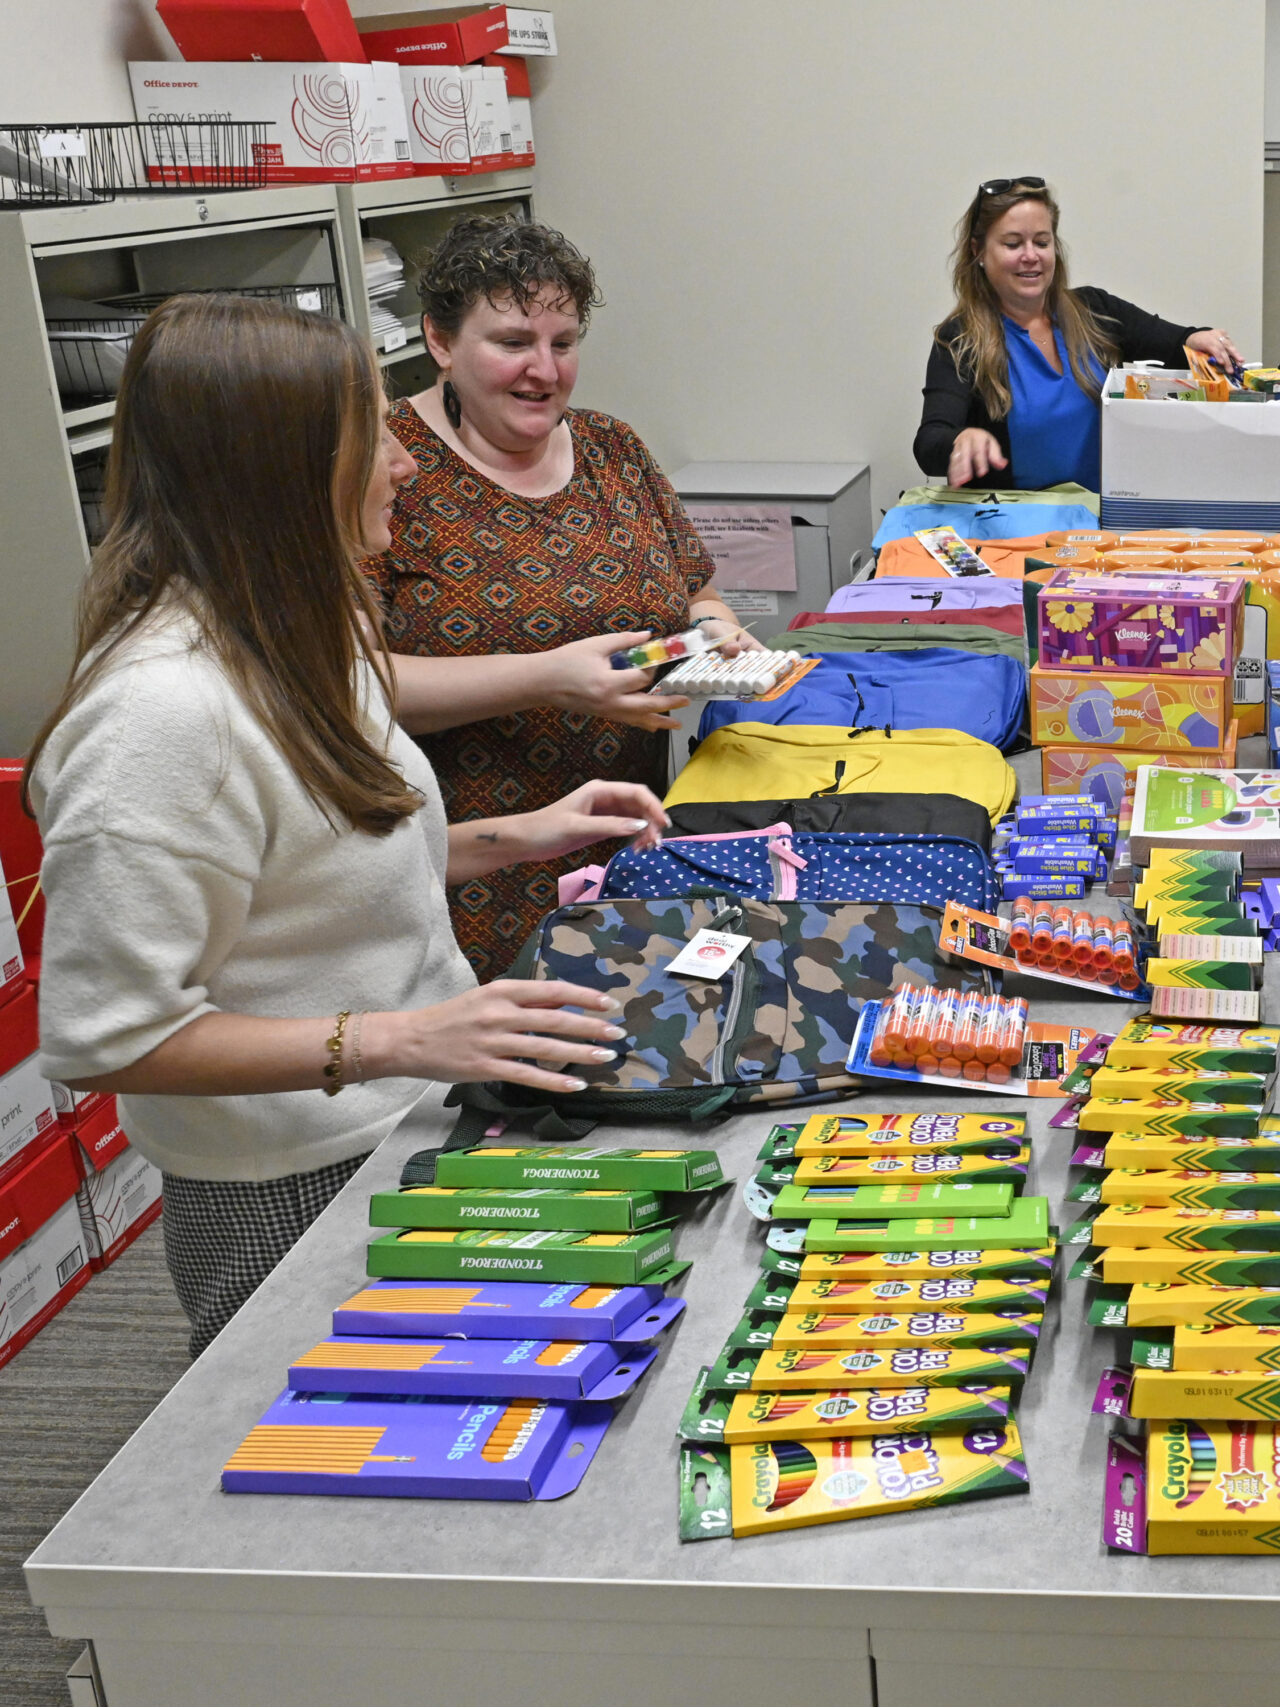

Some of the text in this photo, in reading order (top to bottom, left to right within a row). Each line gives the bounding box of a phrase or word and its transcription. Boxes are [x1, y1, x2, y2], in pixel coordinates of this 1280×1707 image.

[519, 29, 530, 39] UPS
[421, 42, 448, 51] Office
[143, 79, 171, 88] Office
[148, 112, 185, 128] copy
[198, 110, 232, 126] print
[1114, 628, 1151, 642] Kleenex
[1109, 706, 1145, 720] Kleenex
[1070, 1029, 1080, 1050] ELMER'S
[1032, 1045, 1042, 1077] School Glue
[1, 1103, 23, 1129] print
[814, 1118, 839, 1143] Crayola
[910, 1112, 938, 1145] COLORED
[933, 1113, 962, 1143] PENCILS
[987, 1121, 1006, 1132] 12
[94, 1130, 118, 1152] Office
[772, 1146, 794, 1156] 12
[814, 1156, 839, 1171] Cray
[523, 1167, 600, 1179] TICONDEROGA
[771, 1172, 793, 1182] 12
[120, 1179, 135, 1196] copy
[459, 1206, 540, 1218] TICONDEROGA
[0, 1218, 20, 1239] EPOT
[460, 1257, 543, 1270] TICONDEROGA
[776, 1260, 799, 1272] 12
[6, 1282, 24, 1301] copy
[539, 1284, 578, 1309] encils
[762, 1294, 787, 1307] 12
[1105, 1304, 1116, 1316] Classic
[1101, 1315, 1125, 1325] 10
[747, 1331, 772, 1344] 12
[1148, 1345, 1159, 1358] Classic
[1146, 1357, 1170, 1368] 10
[723, 1371, 750, 1385] 12
[747, 1391, 776, 1420] Cray
[1103, 1405, 1122, 1415] 20
[447, 1404, 499, 1461] Pencils
[697, 1418, 725, 1435] 12
[972, 1429, 998, 1450] 12
[1161, 1423, 1190, 1501] Crayola
[1238, 1444, 1247, 1468] Preferred
[752, 1441, 770, 1508] Crayola
[880, 1436, 912, 1498] COLOR
[701, 1508, 728, 1530] 12
[1126, 1511, 1134, 1528] Colors
[1115, 1526, 1133, 1547] 20
